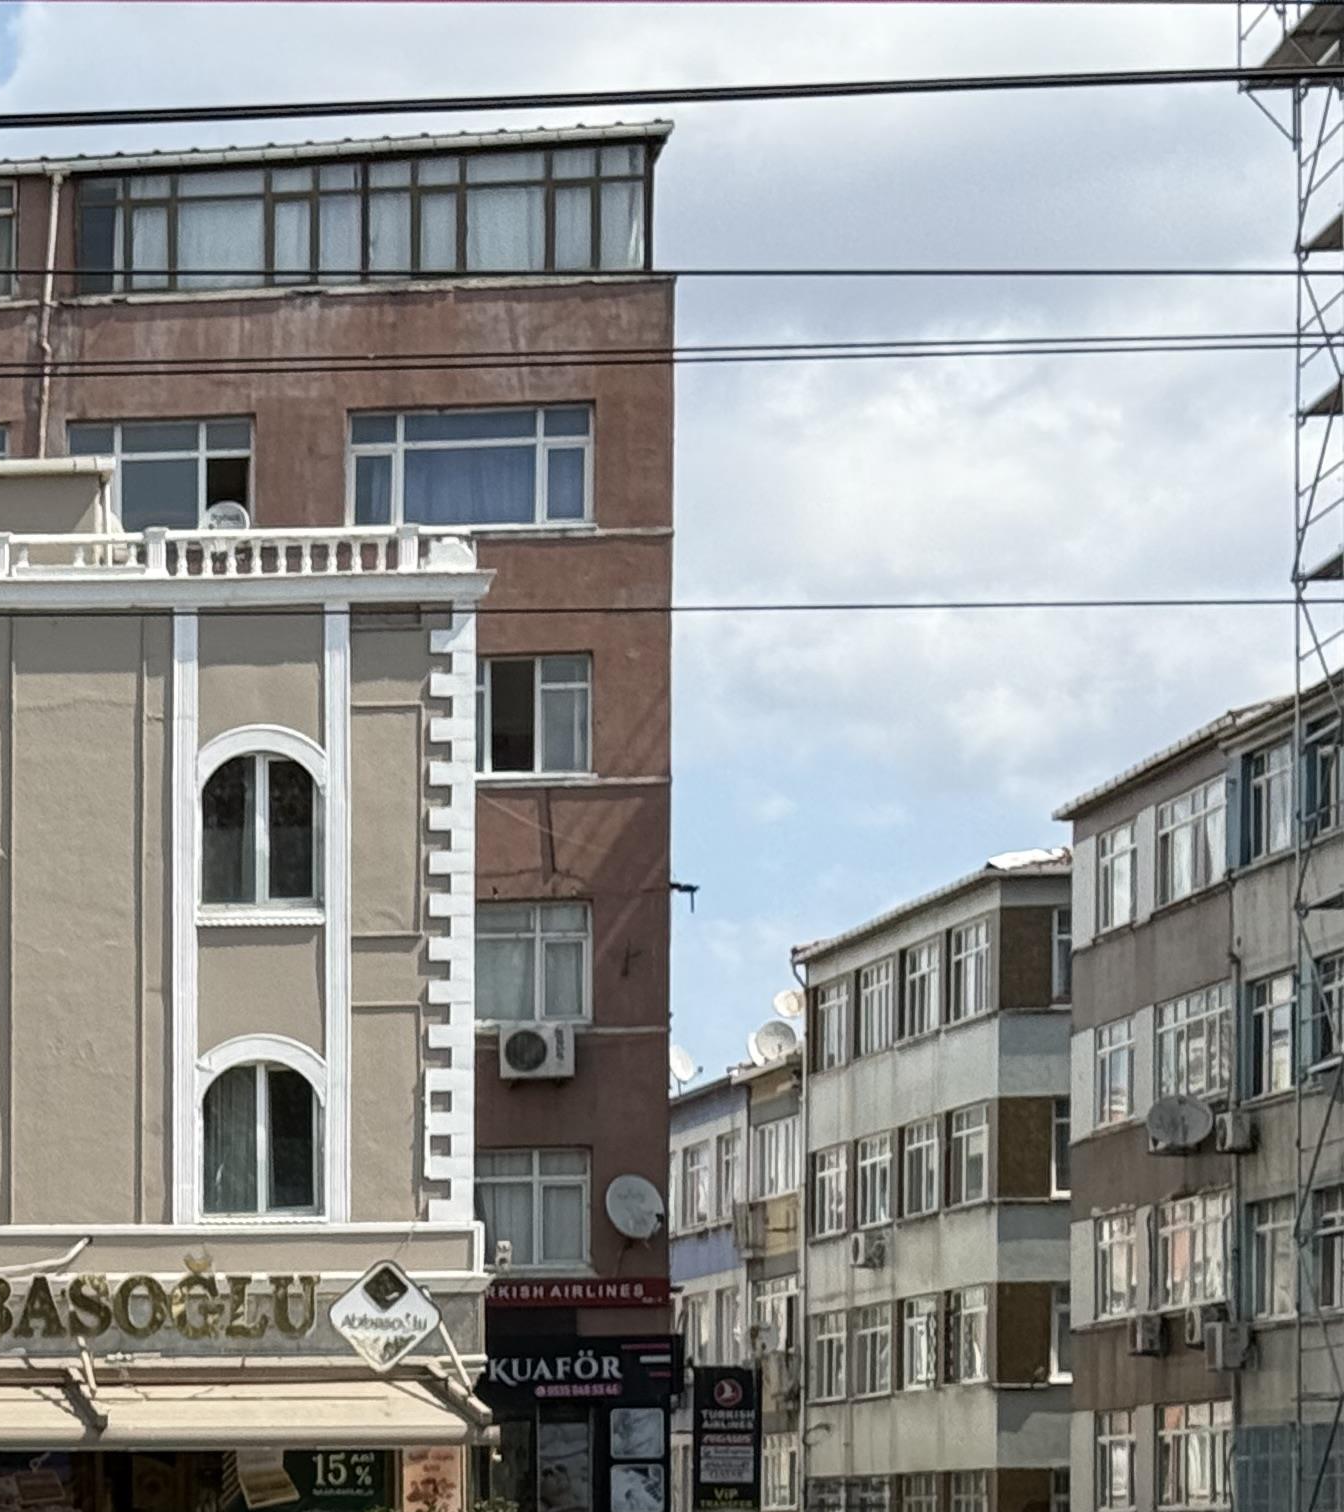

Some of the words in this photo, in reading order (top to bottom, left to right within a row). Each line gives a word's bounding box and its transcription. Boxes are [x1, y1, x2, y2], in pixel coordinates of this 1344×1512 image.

[485, 1285, 544, 1299] RKISH
[550, 1282, 644, 1299] AIRLINES
[488, 1349, 623, 1386] KUAFÖR
